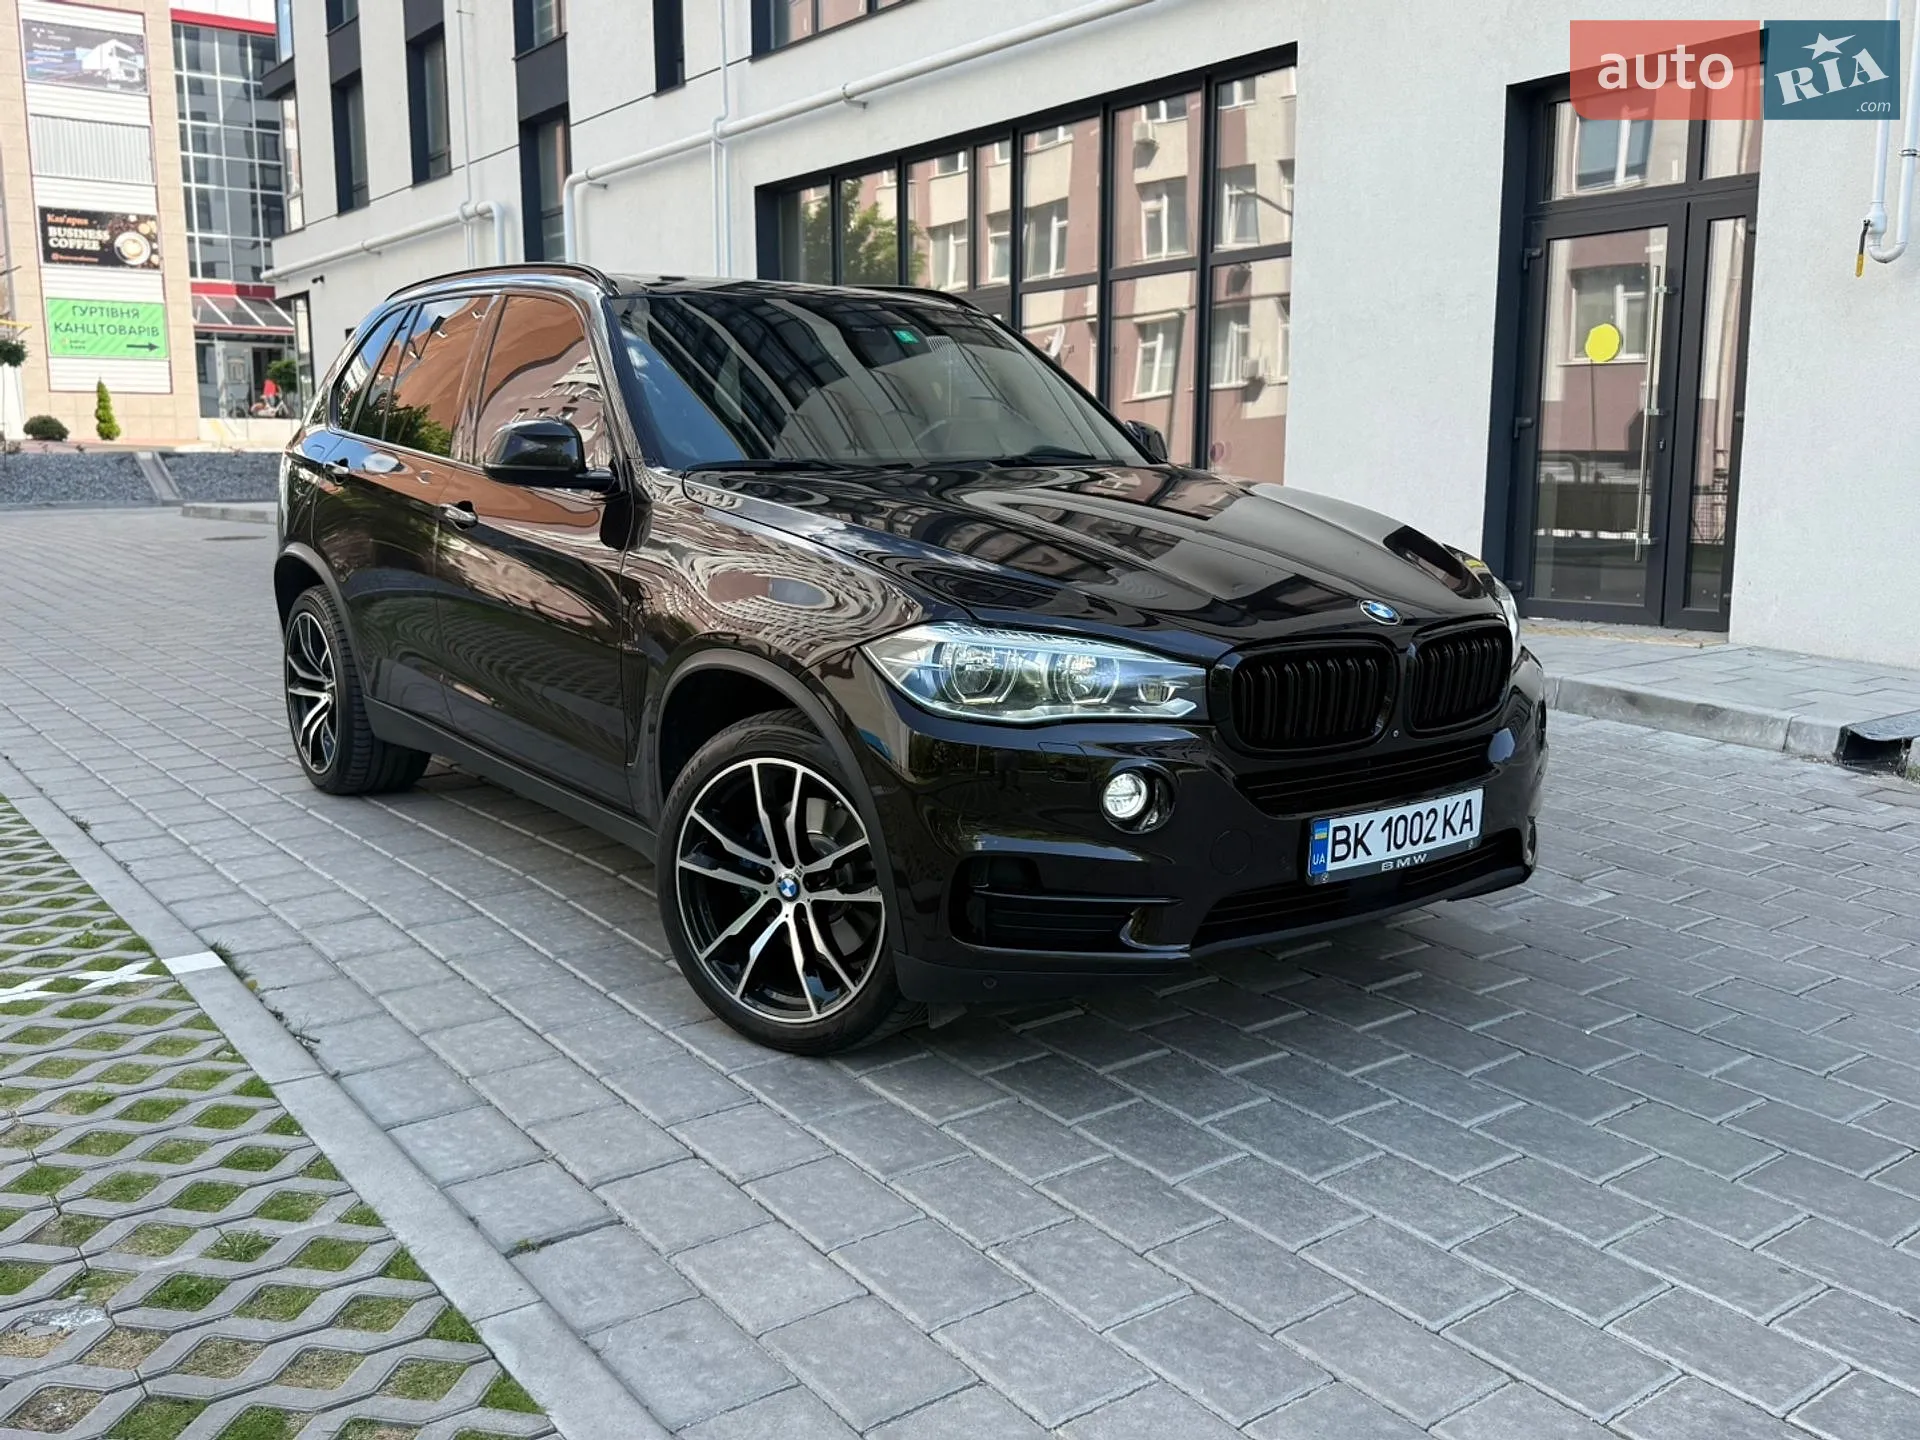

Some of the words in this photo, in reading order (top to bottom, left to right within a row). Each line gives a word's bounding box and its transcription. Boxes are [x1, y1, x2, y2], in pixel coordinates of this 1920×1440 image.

[48, 226, 110, 240] BUSINESS
[49, 237, 100, 251] COFFEE
[72, 305, 140, 319] ГУРТІВНЯ
[54, 322, 160, 337] КАНЦТОВАРІВ
[1330, 819, 1375, 864] BK
[1381, 808, 1438, 852] 1002
[1442, 798, 1474, 840] KA
[1312, 853, 1326, 866] UA
[1381, 852, 1428, 872] BMW
